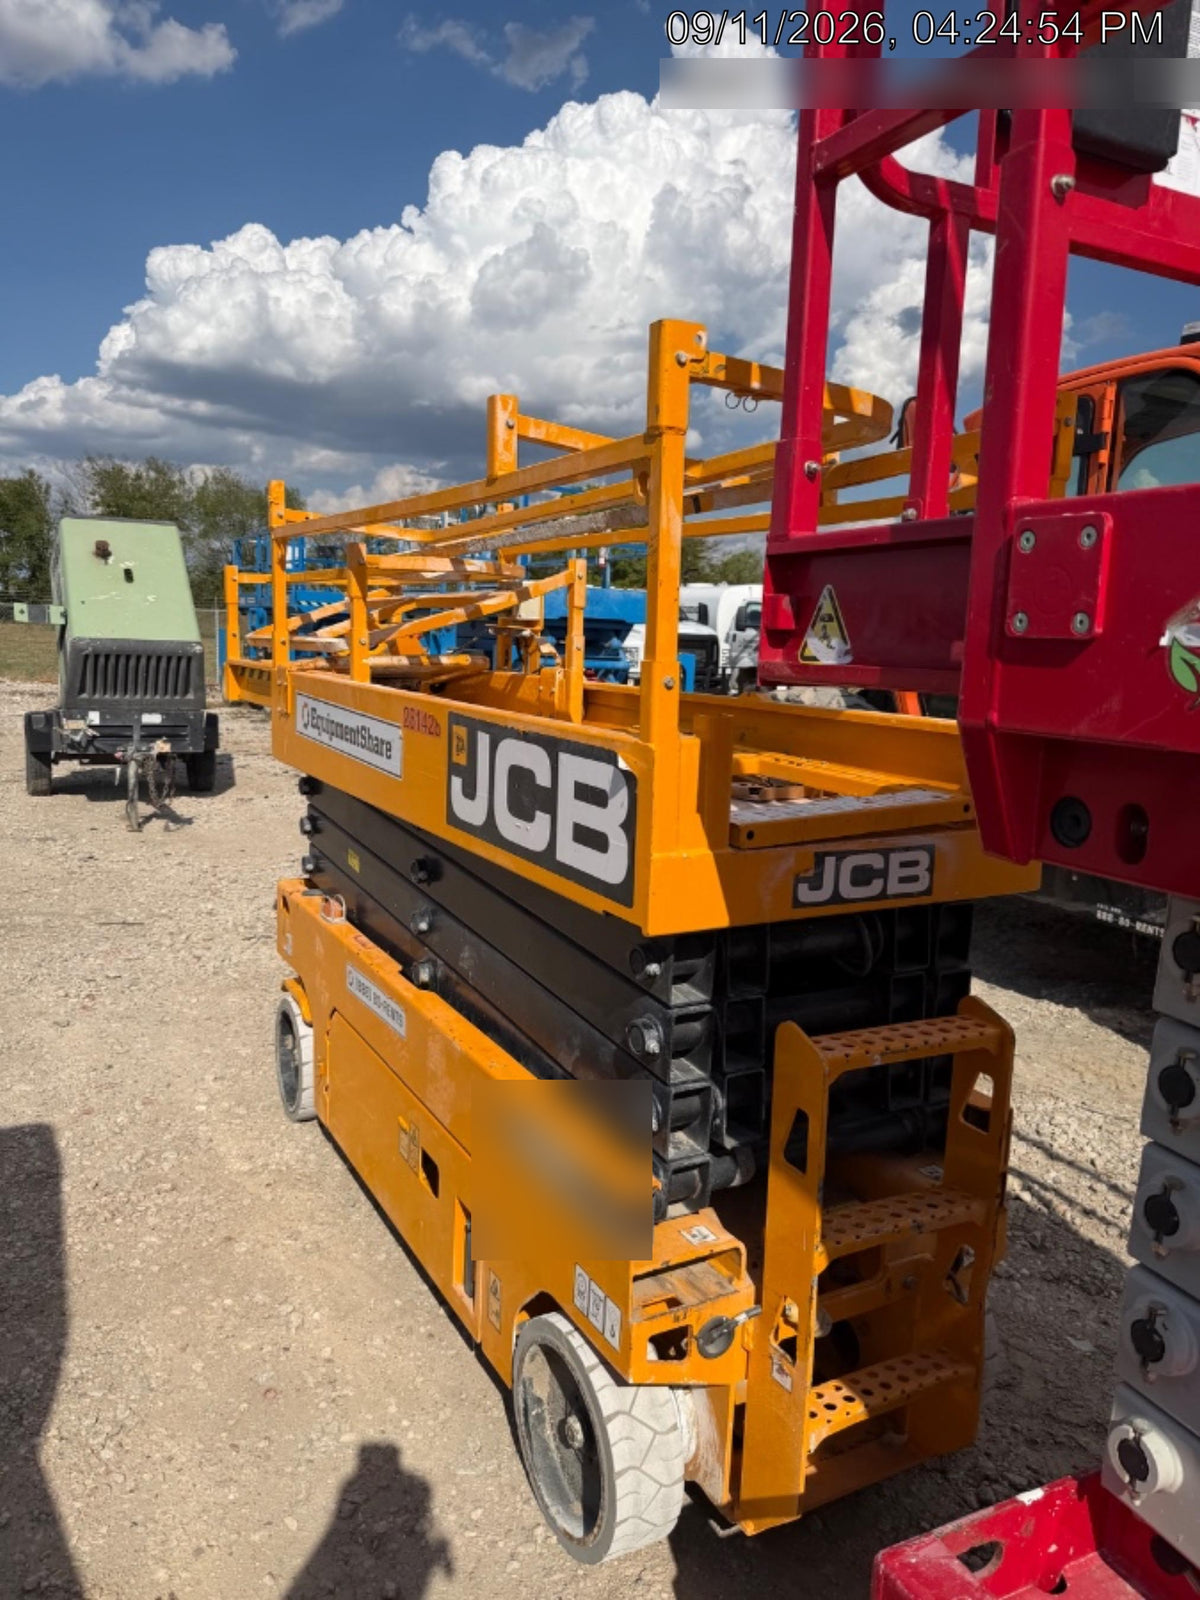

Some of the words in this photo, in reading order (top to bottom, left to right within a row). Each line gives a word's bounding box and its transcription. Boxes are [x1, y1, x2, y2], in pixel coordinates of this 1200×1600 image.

[310, 706, 392, 760] EquipmentShare
[451, 730, 629, 885] JCB
[797, 850, 930, 902] JCB
